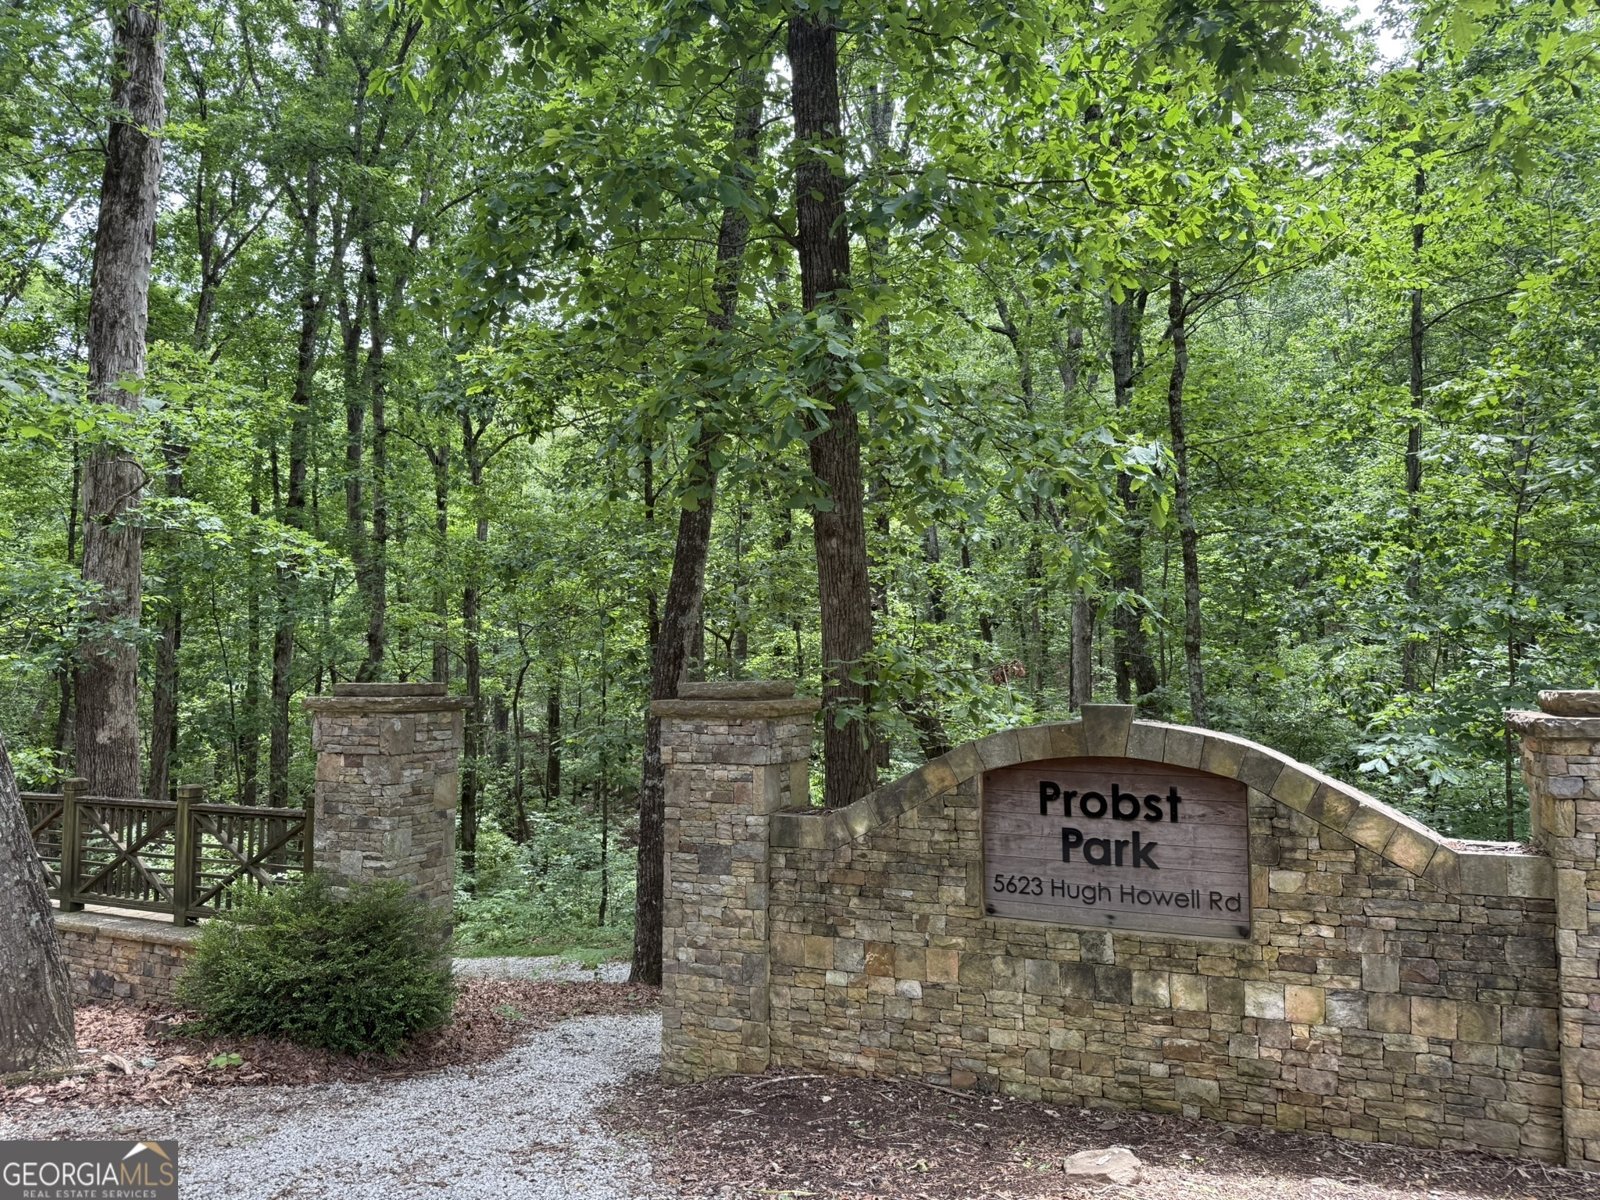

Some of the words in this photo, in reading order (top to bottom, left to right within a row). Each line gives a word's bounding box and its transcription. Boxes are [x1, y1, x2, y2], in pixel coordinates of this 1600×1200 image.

[1039, 780, 1182, 823] Probst
[1061, 827, 1160, 870] Park
[992, 874, 1044, 896] 5623
[1051, 879, 1112, 905] Hugh
[1120, 884, 1201, 909] Howell
[1210, 891, 1242, 912] Rd
